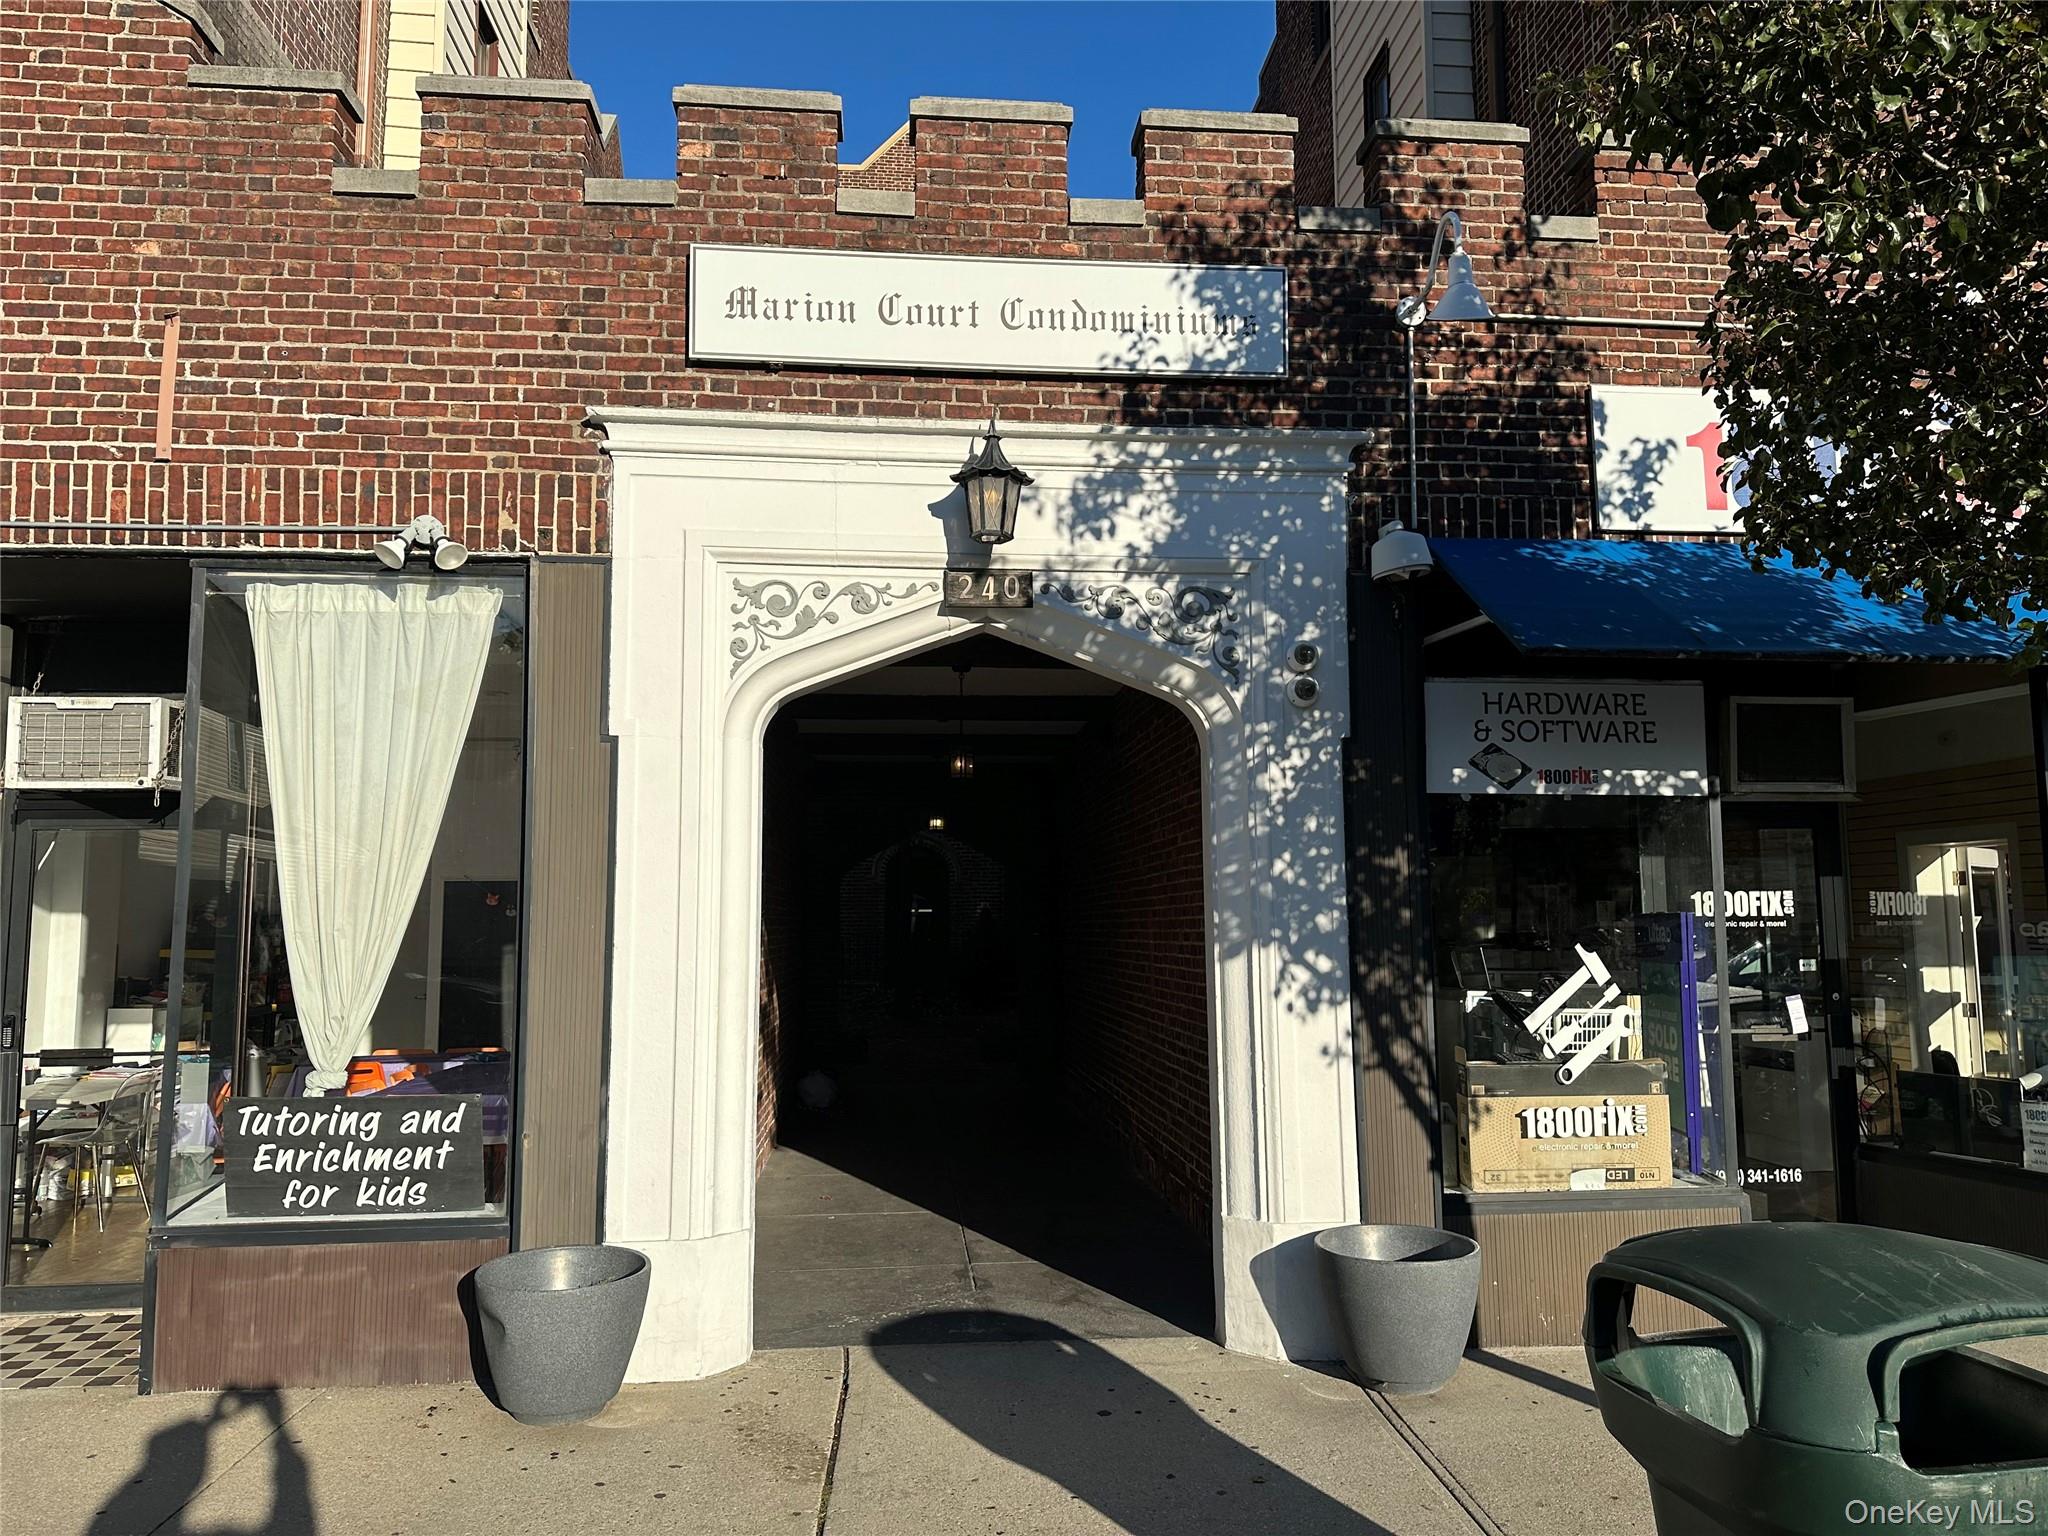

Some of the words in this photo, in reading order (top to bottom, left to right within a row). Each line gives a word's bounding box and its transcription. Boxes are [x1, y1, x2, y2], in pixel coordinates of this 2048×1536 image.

[724, 284, 857, 325] Marion
[877, 291, 981, 330] Court
[1000, 297, 1258, 337] Condominiums
[958, 574, 1020, 601] 240
[1481, 691, 1648, 717] HARDWARE
[1473, 719, 1492, 743] &
[1501, 719, 1658, 744] SOFTWARE
[1738, 920, 1759, 929] repair
[237, 1104, 382, 1142] Tutoring
[399, 1102, 467, 1134] and
[252, 1139, 455, 1173] Enrichment
[1538, 1142, 1579, 1152] electronic
[1606, 1169, 1629, 1180] LED
[1747, 1168, 1803, 1183] 341-1616
[282, 1179, 340, 1209] for
[356, 1175, 429, 1208] kids
